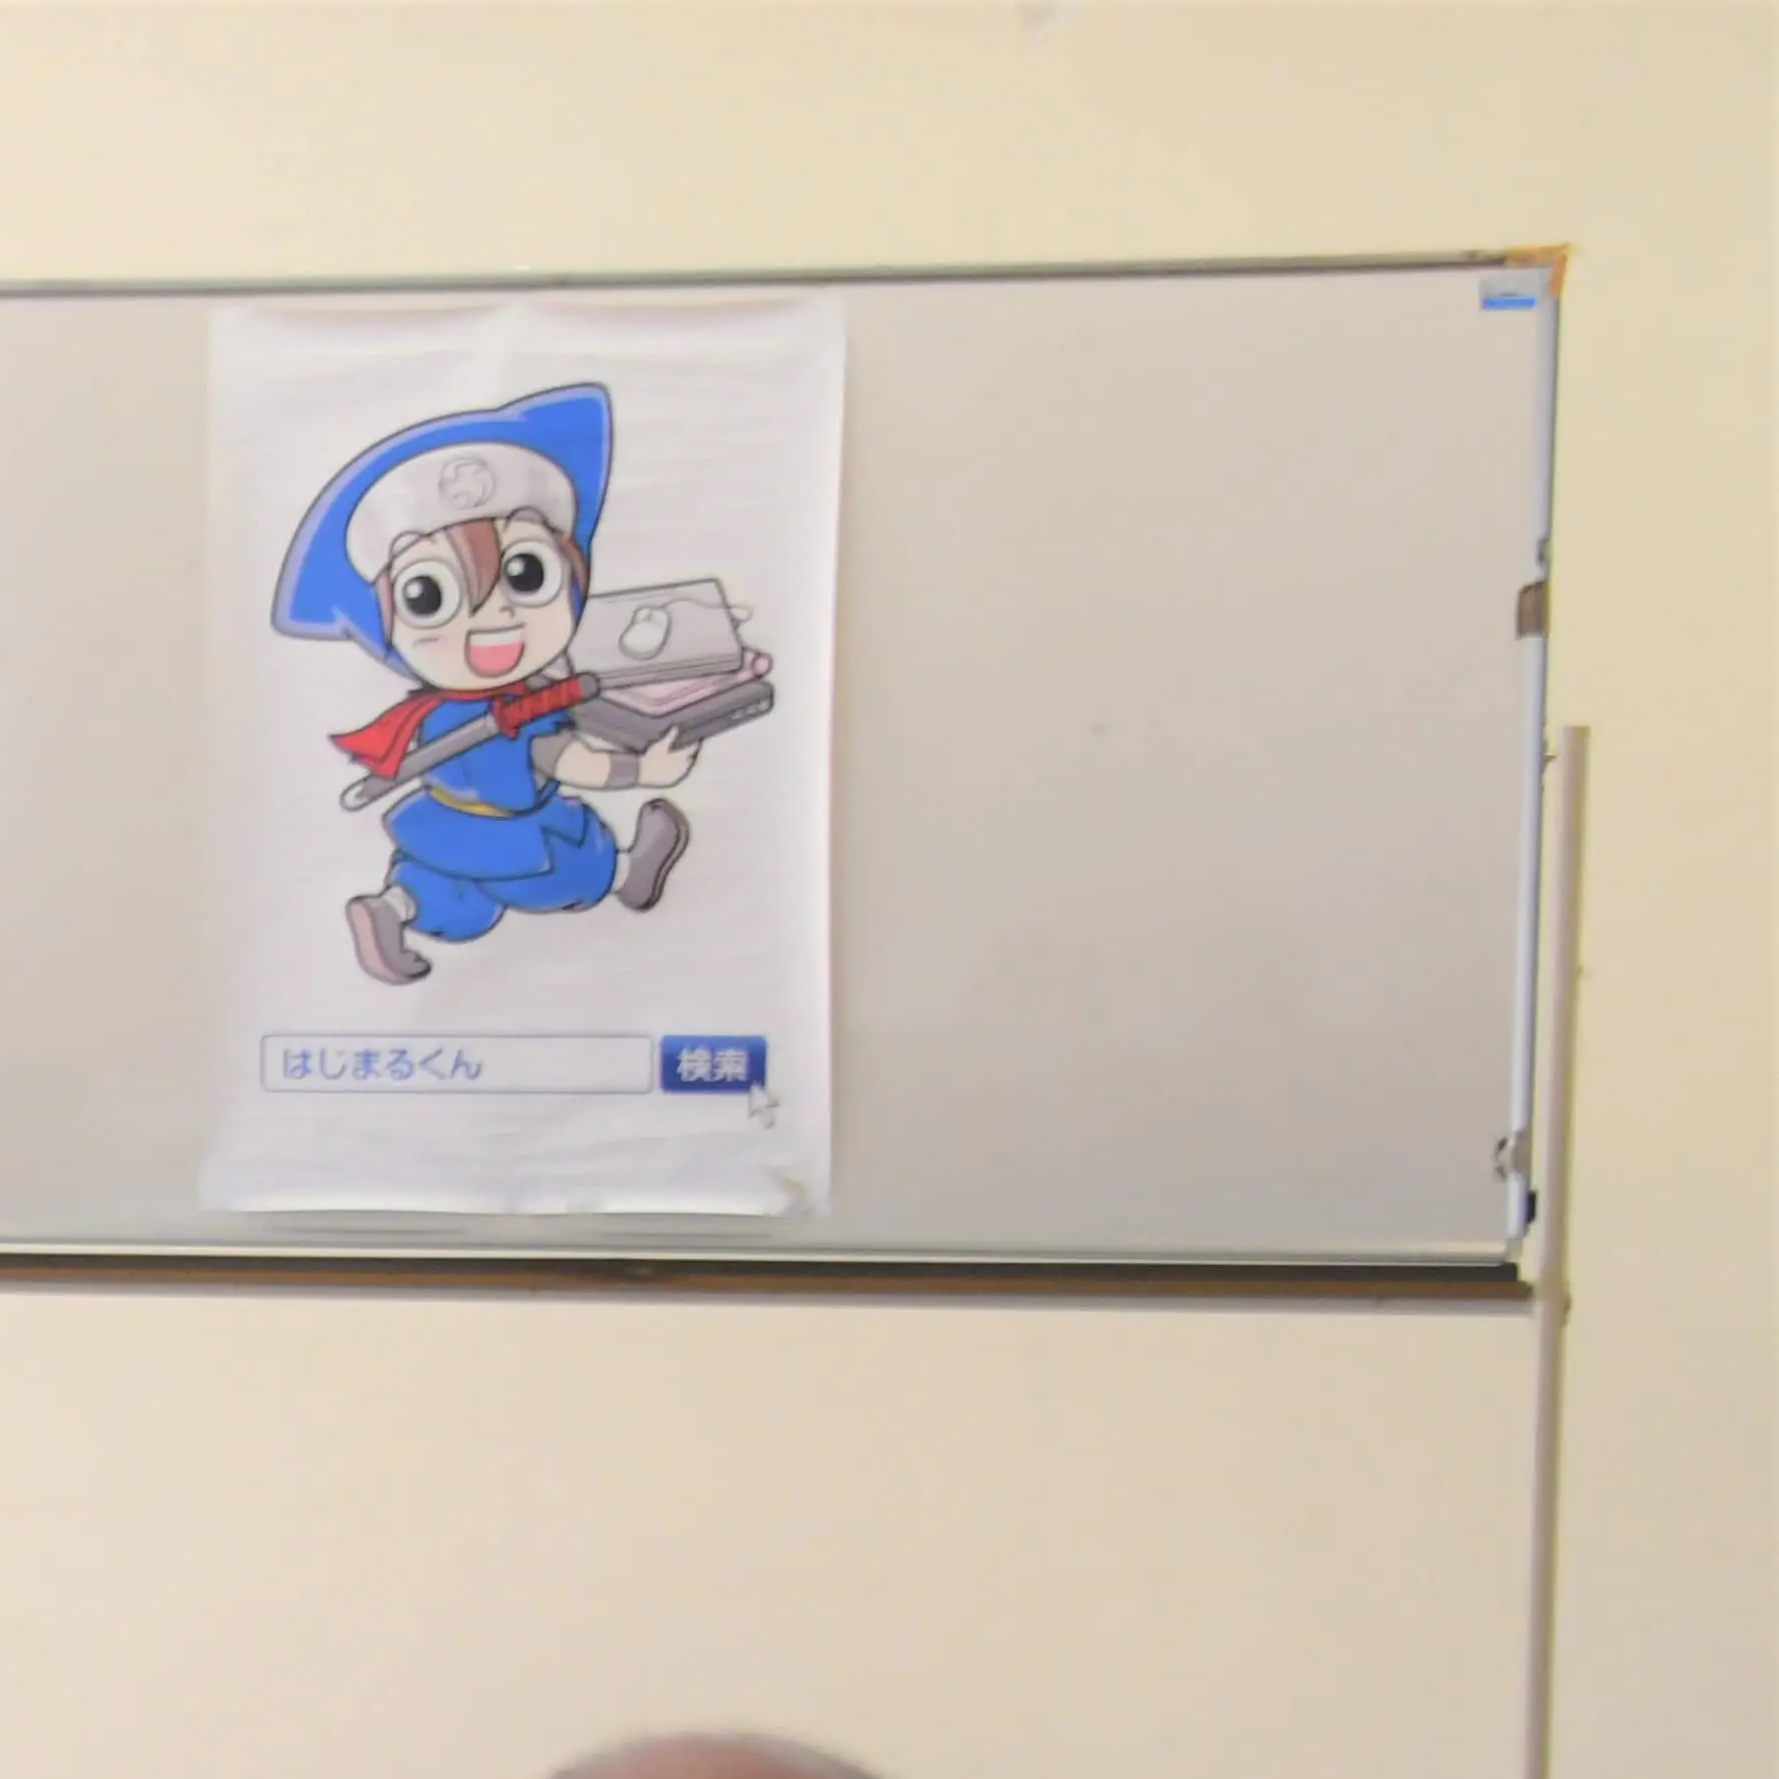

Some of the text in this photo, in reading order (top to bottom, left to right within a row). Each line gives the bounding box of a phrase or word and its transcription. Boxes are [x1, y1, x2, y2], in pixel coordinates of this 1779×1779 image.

[282, 1047, 748, 1082] はじまるくん 検索
